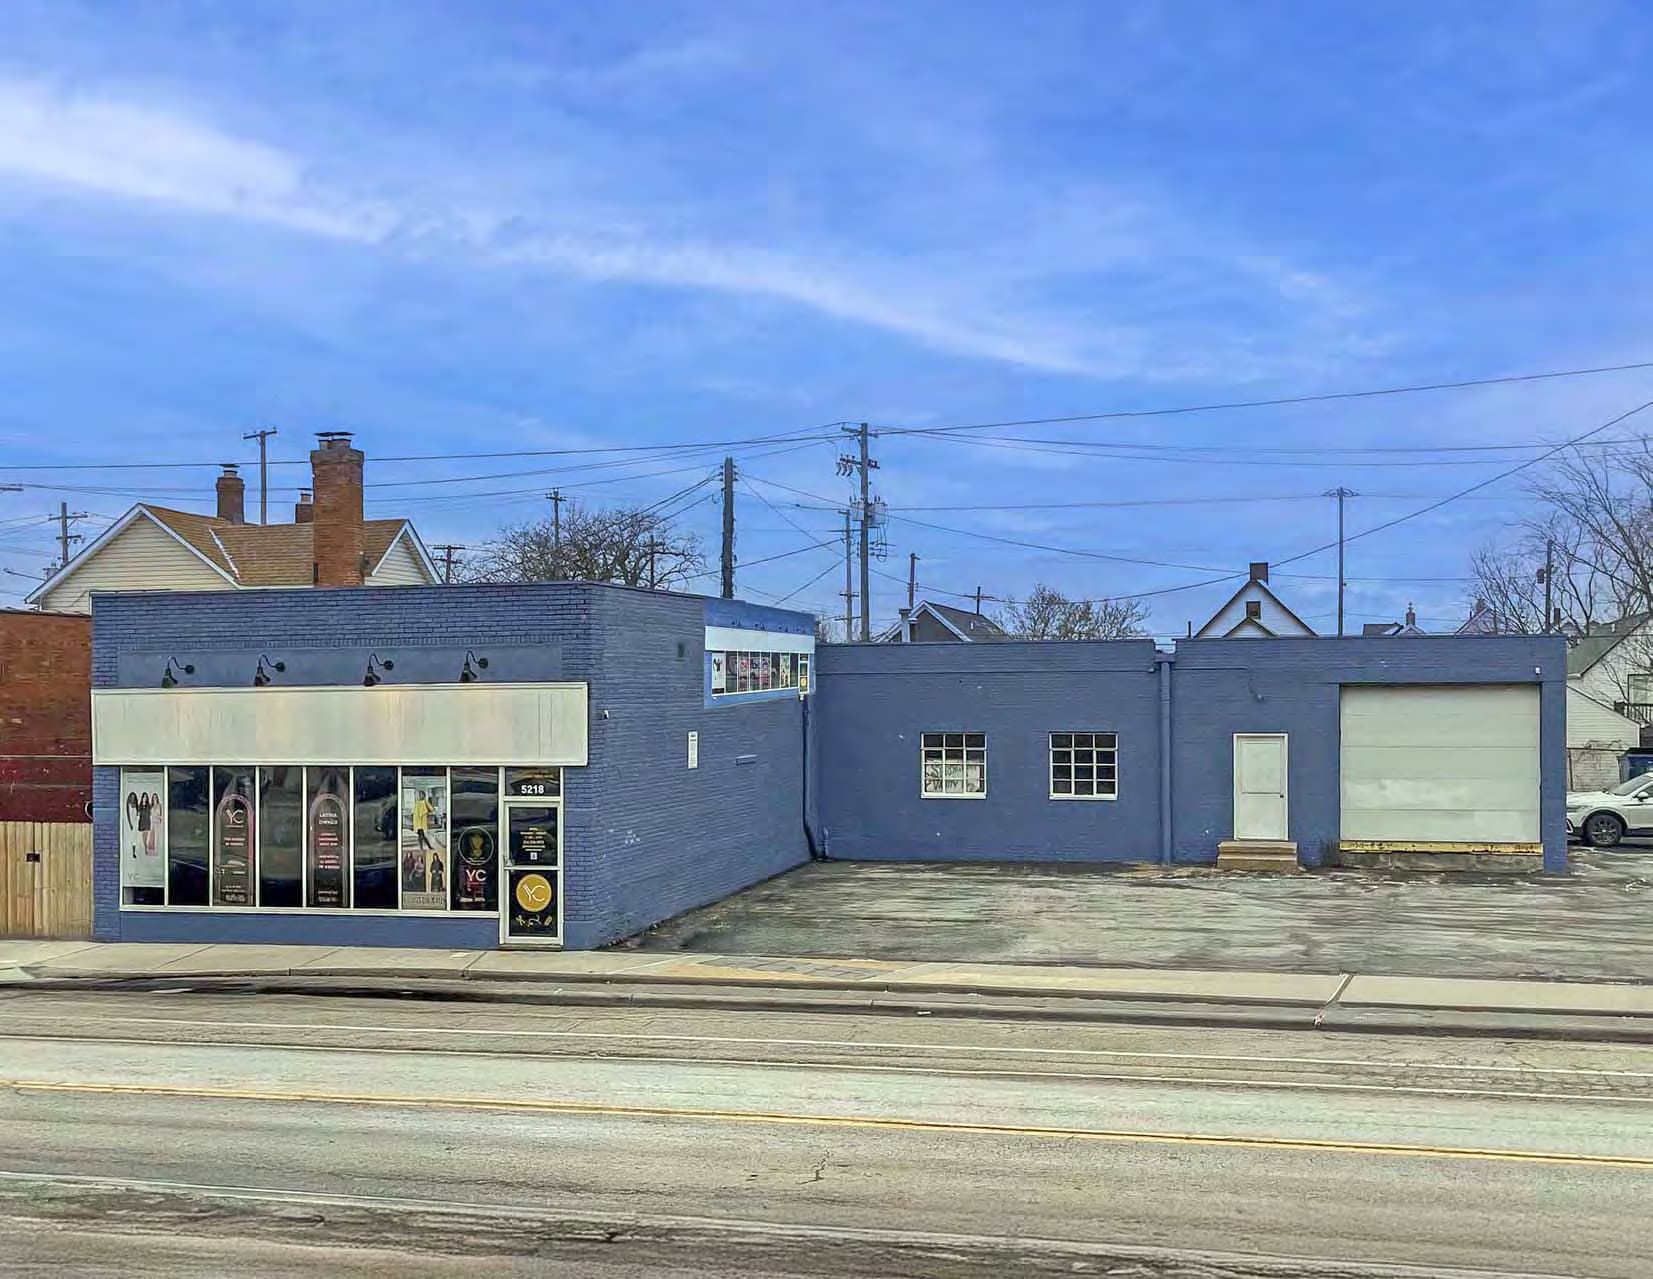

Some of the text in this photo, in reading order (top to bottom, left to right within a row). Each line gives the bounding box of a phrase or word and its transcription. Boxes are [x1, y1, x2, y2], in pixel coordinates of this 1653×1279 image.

[521, 785, 545, 794] 5218
[226, 809, 244, 824] YC
[466, 869, 487, 881] YC
[522, 883, 546, 902] YC
